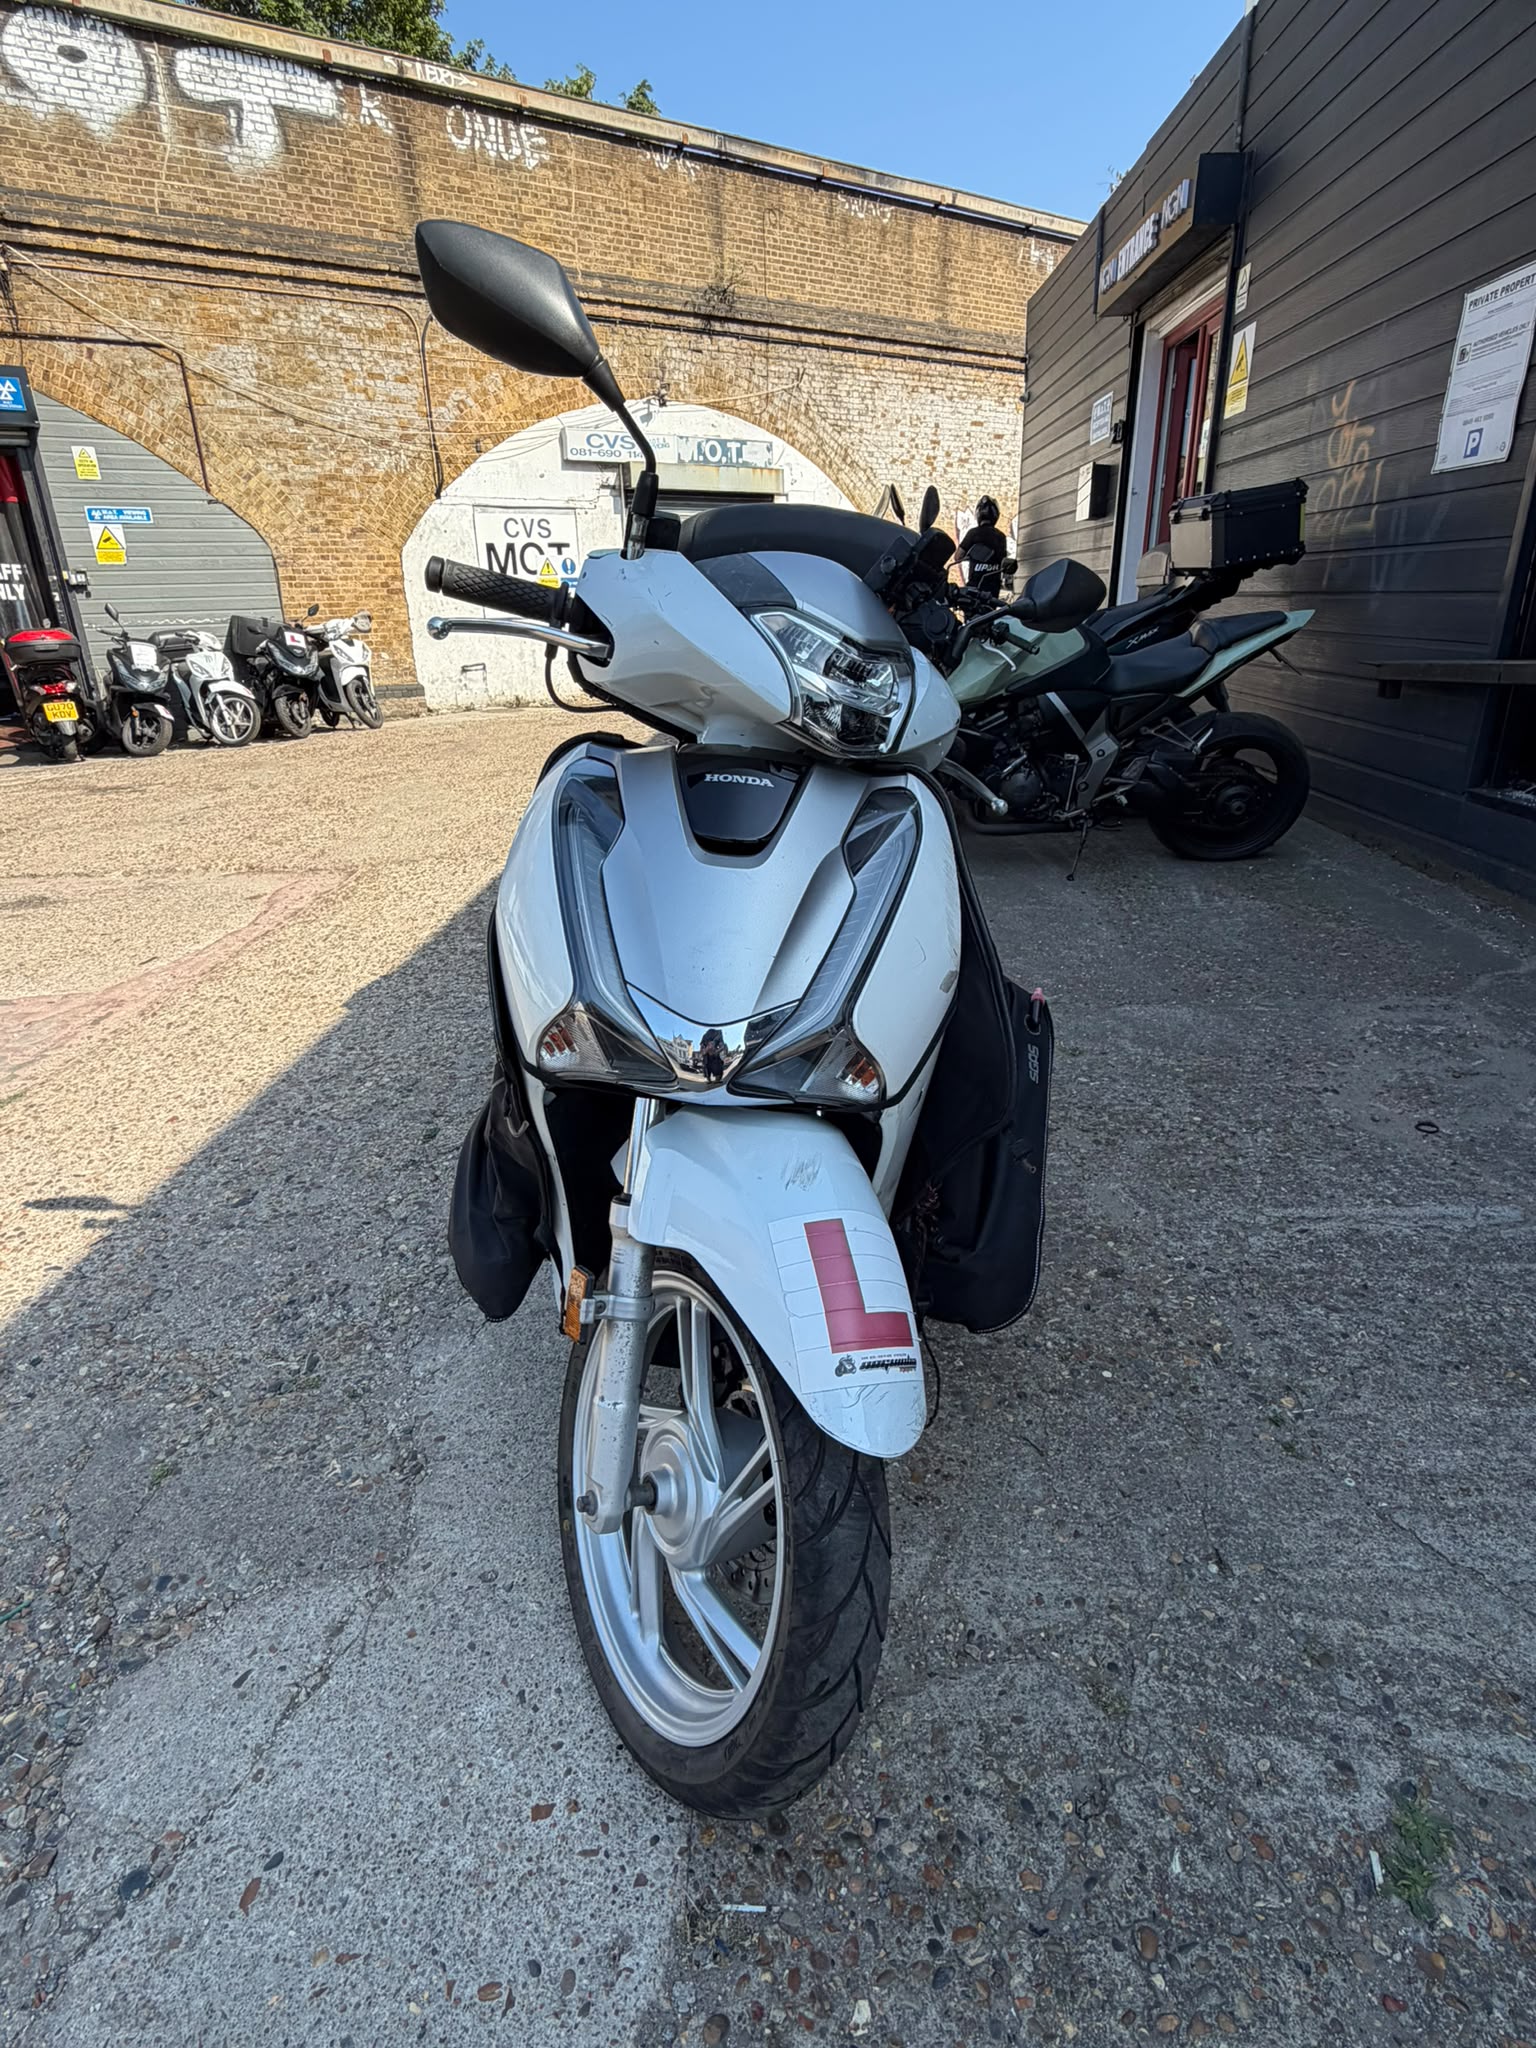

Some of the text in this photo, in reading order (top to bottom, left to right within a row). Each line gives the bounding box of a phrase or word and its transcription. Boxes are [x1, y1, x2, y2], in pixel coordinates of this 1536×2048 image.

[1468, 289, 1500, 310] PRIVATE
[586, 433, 636, 450] CVS
[569, 447, 622, 458] 081-690
[503, 517, 552, 539] CVS
[704, 773, 775, 788] HONDA
[1028, 1043, 1039, 1084] SGAS
[803, 1217, 914, 1354] L
